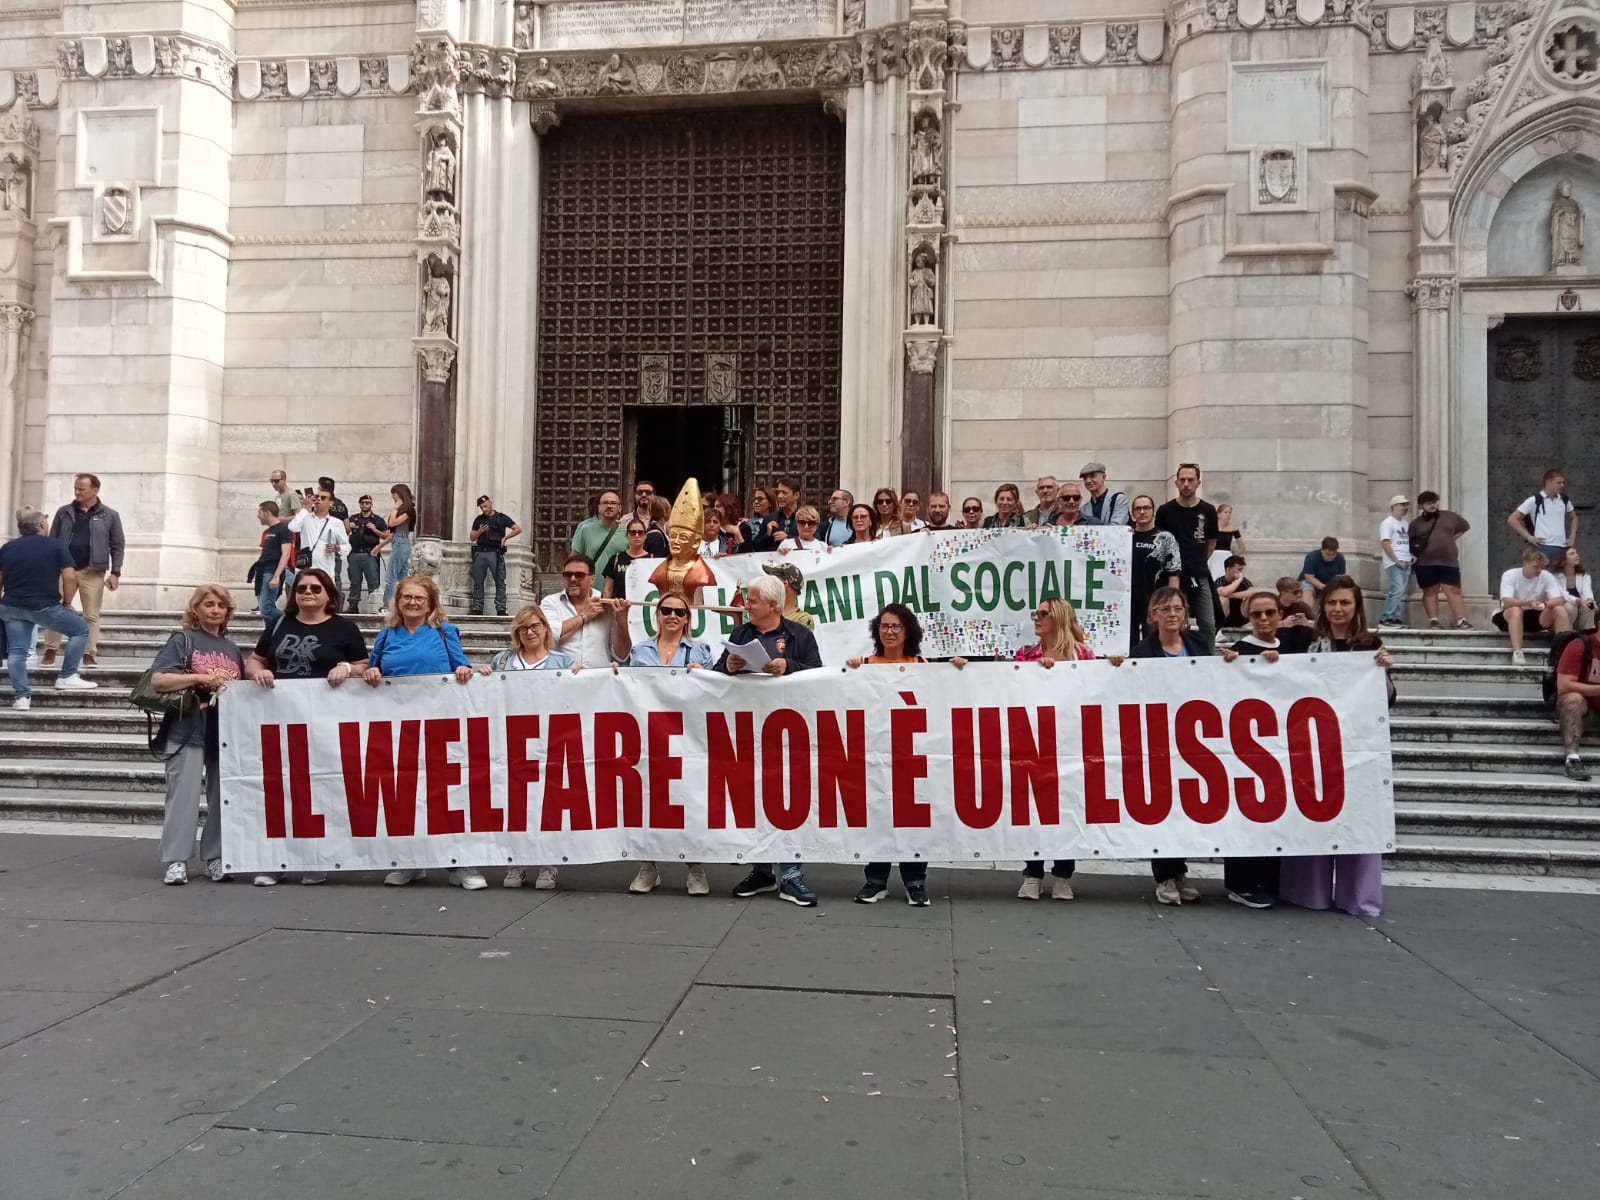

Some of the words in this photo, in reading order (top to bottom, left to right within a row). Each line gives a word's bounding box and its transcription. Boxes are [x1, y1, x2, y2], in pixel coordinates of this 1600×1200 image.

[796, 573, 865, 624] ANI
[874, 565, 941, 613] DAL
[950, 559, 1106, 612] SOCIALE
[261, 724, 325, 838] IL
[338, 711, 685, 838] WELFARE
[707, 708, 868, 830] NON
[890, 691, 932, 828] È
[951, 705, 1061, 829] UN
[1081, 696, 1346, 826] LUSSO
